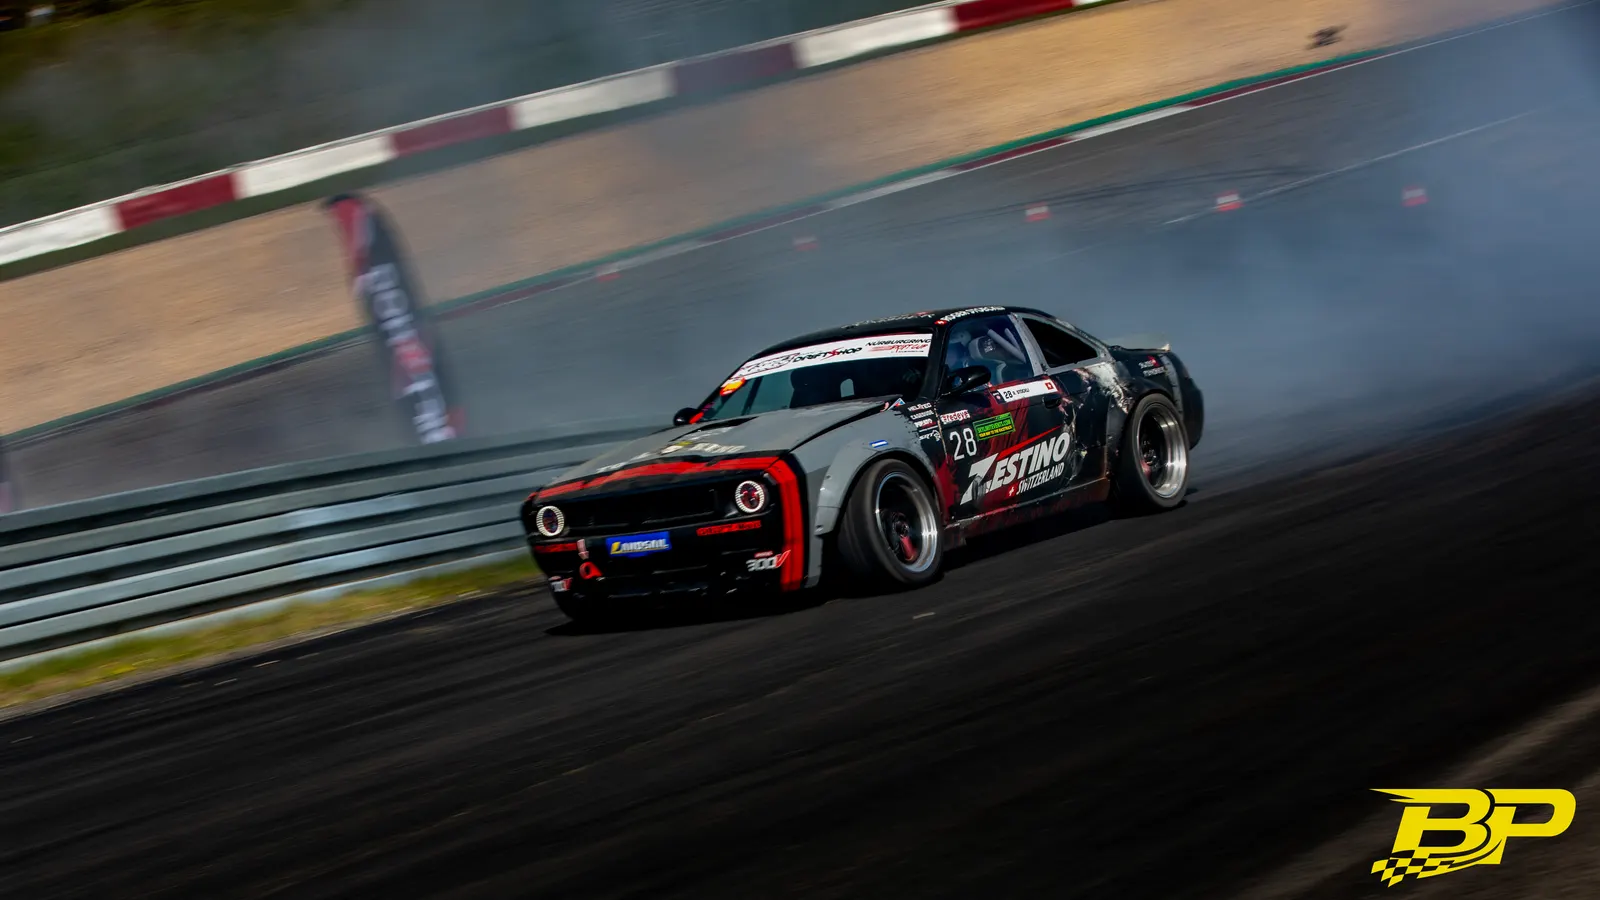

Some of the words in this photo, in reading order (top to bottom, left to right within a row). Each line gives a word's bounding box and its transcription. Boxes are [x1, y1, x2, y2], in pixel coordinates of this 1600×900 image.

[1003, 390, 1013, 399] 28
[950, 427, 977, 461] 28
[960, 432, 1071, 506] ZESTINO
[1016, 461, 1065, 496] SWITZERLAND
[745, 549, 791, 572] 300V
